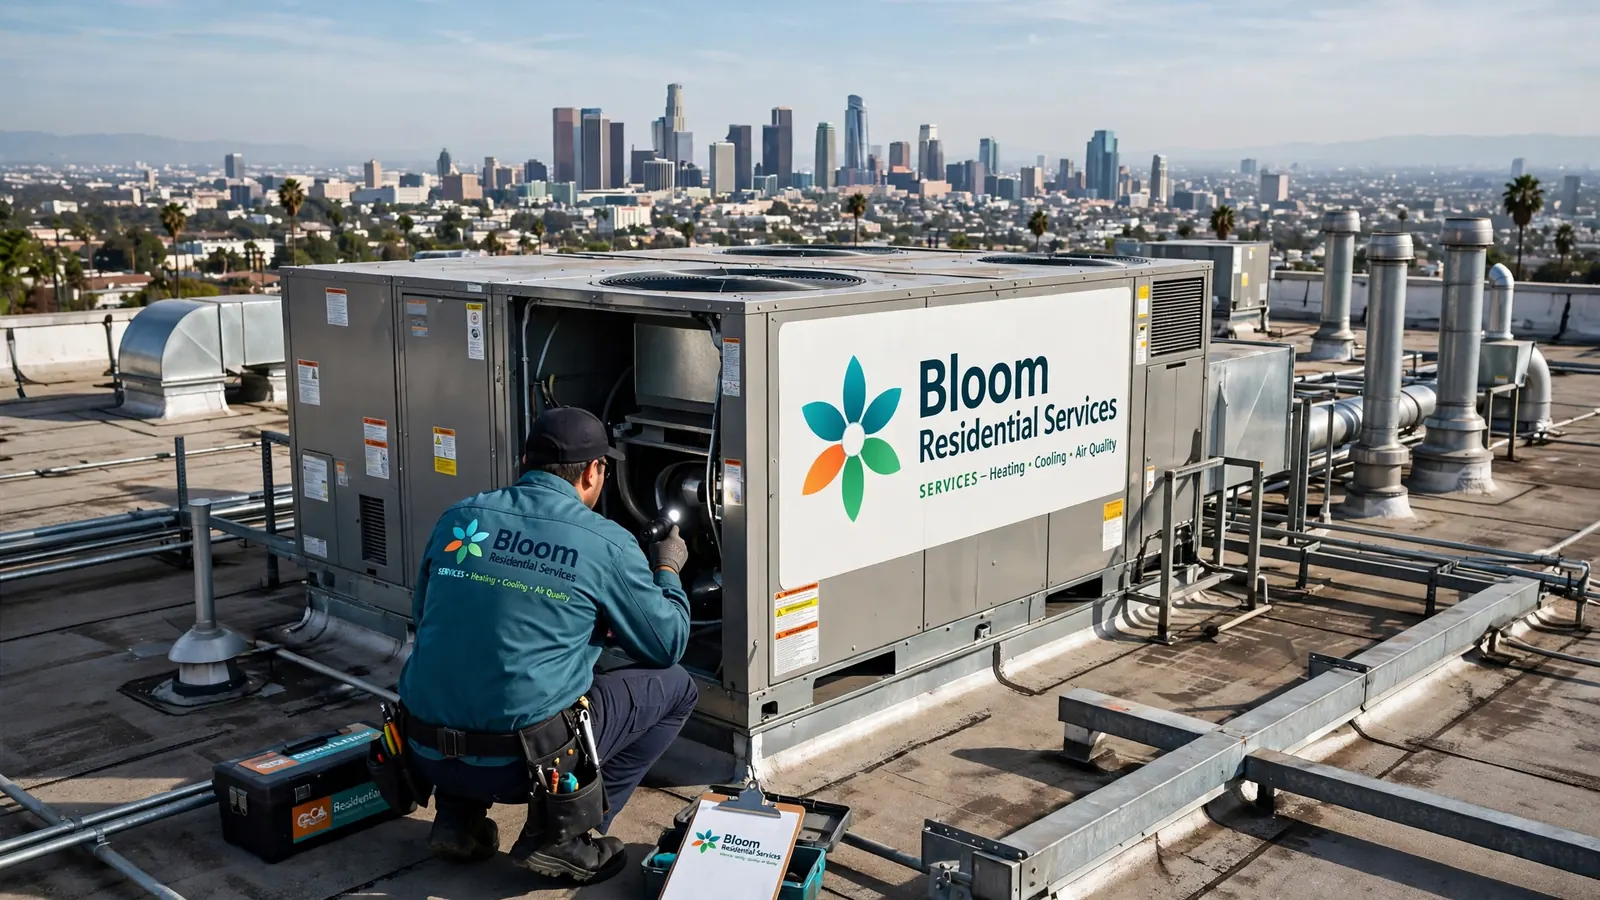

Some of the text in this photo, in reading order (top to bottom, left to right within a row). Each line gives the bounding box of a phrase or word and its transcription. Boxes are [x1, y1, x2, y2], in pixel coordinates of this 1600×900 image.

[919, 353, 1049, 419] Bloom
[919, 395, 1117, 464] Residential Services
[919, 438, 1117, 499] SERVICES Heating Cooling Air Quality
[492, 528, 579, 568] Bloom
[437, 567, 571, 604] SERVICES Heating Cooling Air Quality
[488, 552, 577, 583] Residential Services
[721, 844, 755, 854] Residential
[756, 850, 782, 860] Services
[723, 834, 760, 848] Bloom
